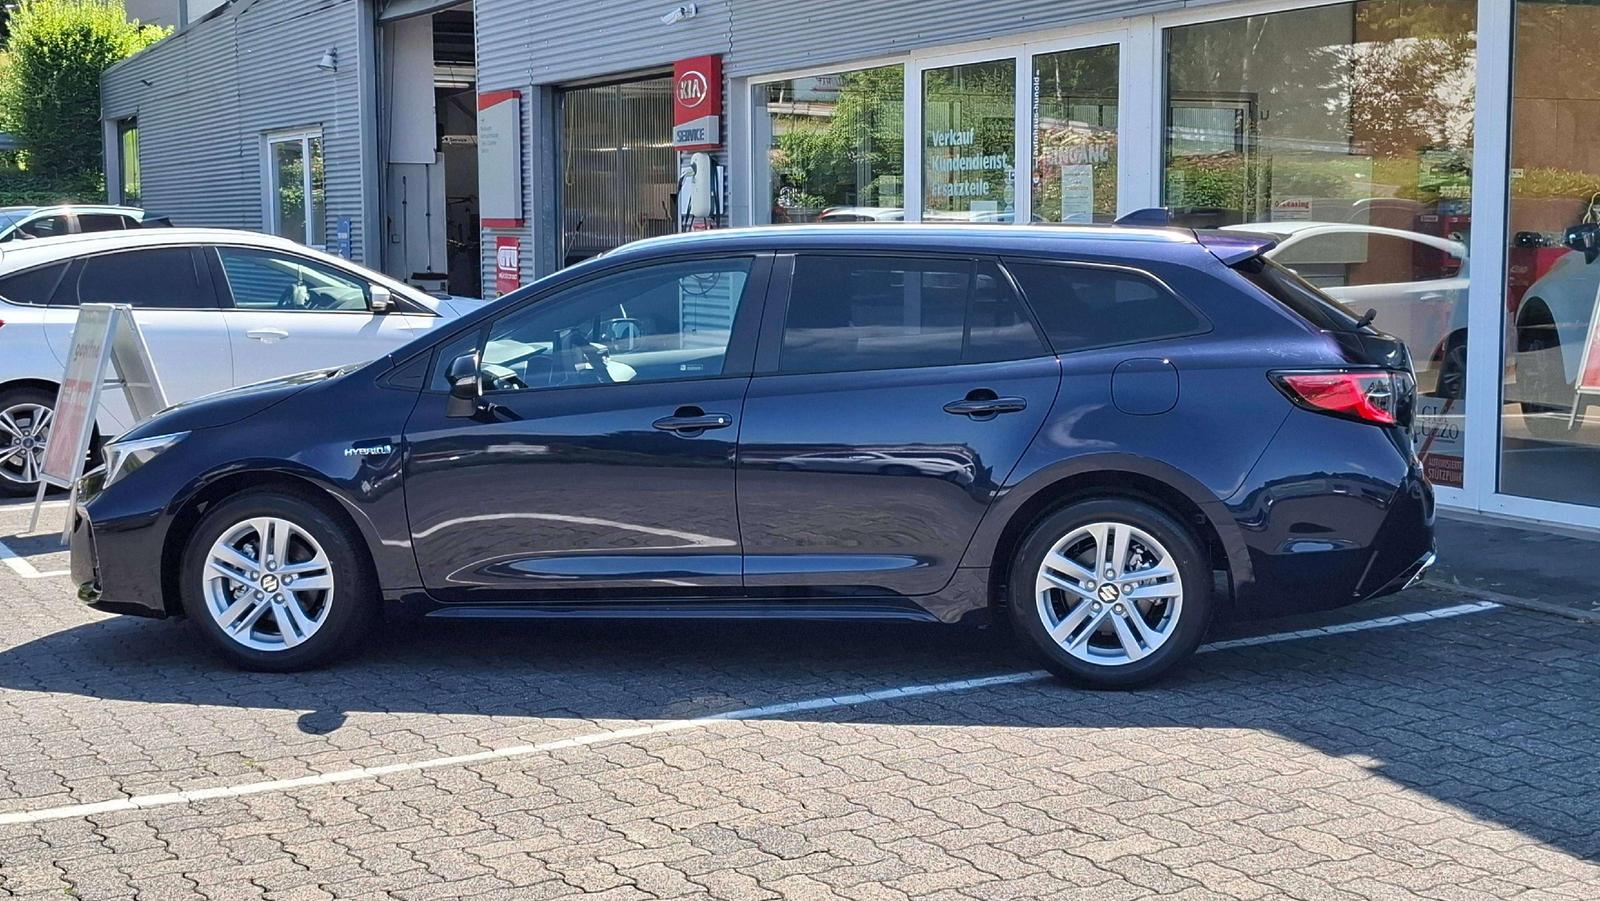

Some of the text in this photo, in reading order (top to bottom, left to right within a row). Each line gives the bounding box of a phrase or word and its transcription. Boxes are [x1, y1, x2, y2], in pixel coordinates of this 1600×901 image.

[680, 79, 700, 99] KIA
[677, 127, 704, 142] SERVICE
[932, 127, 974, 147] Verkauf
[932, 152, 1008, 172] Kundendienst
[932, 178, 990, 197] Ersatzteile
[344, 445, 391, 457] HYBRID
